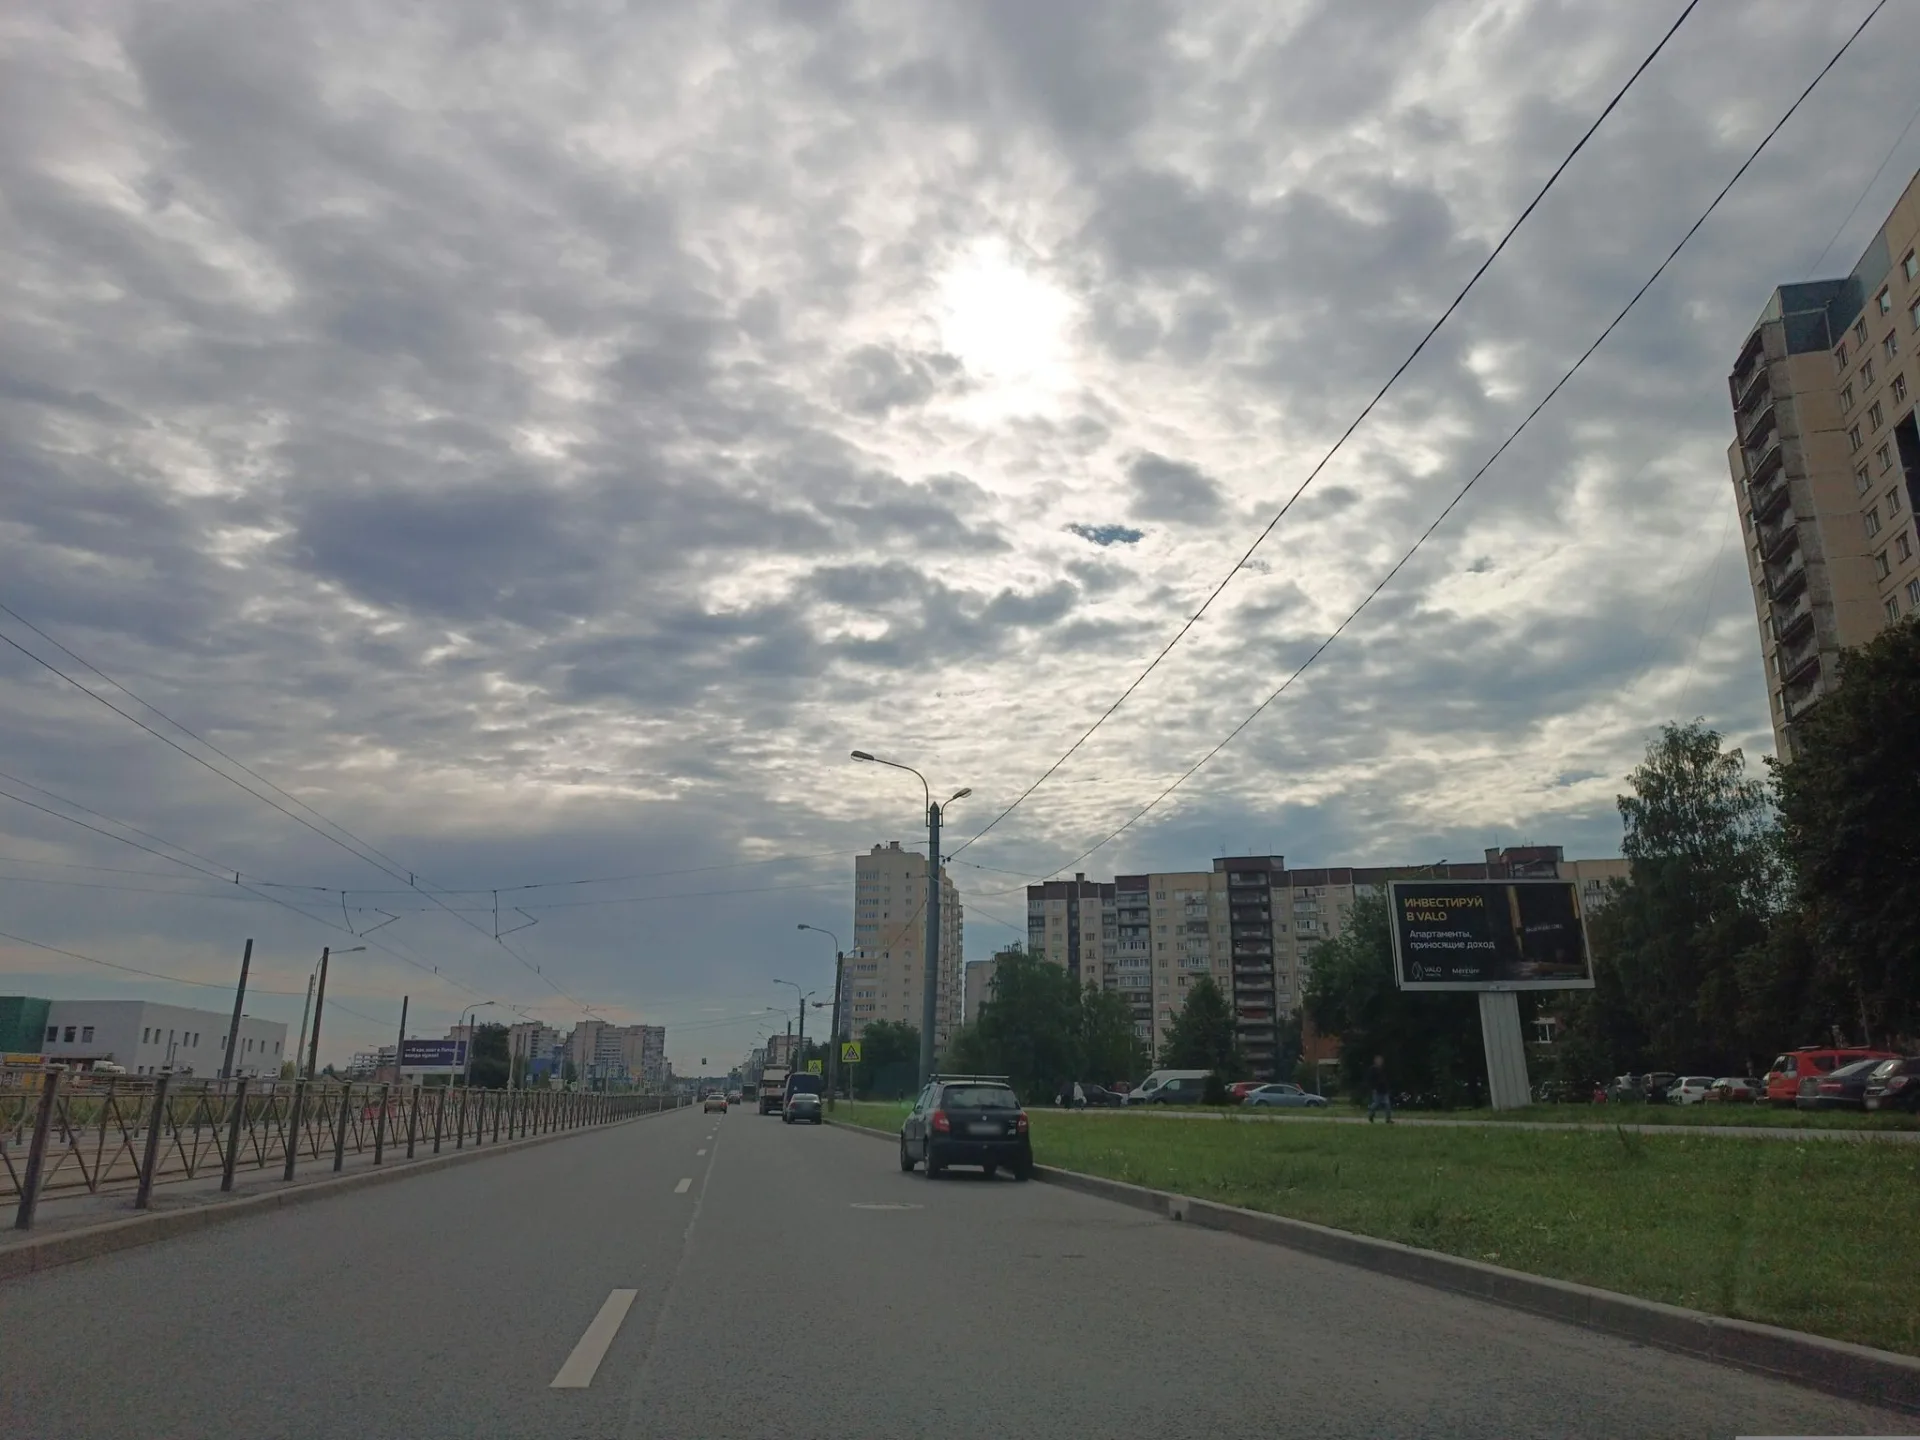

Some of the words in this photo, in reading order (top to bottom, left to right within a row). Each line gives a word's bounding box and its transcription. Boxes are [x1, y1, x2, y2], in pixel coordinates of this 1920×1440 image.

[1404, 896, 1483, 907] ИНВЕСТИРУЙ
[1417, 912, 1448, 921] VALO
[1410, 930, 1472, 939] Апартаменты,
[1410, 942, 1465, 950] приносящие
[1467, 941, 1495, 950] доход
